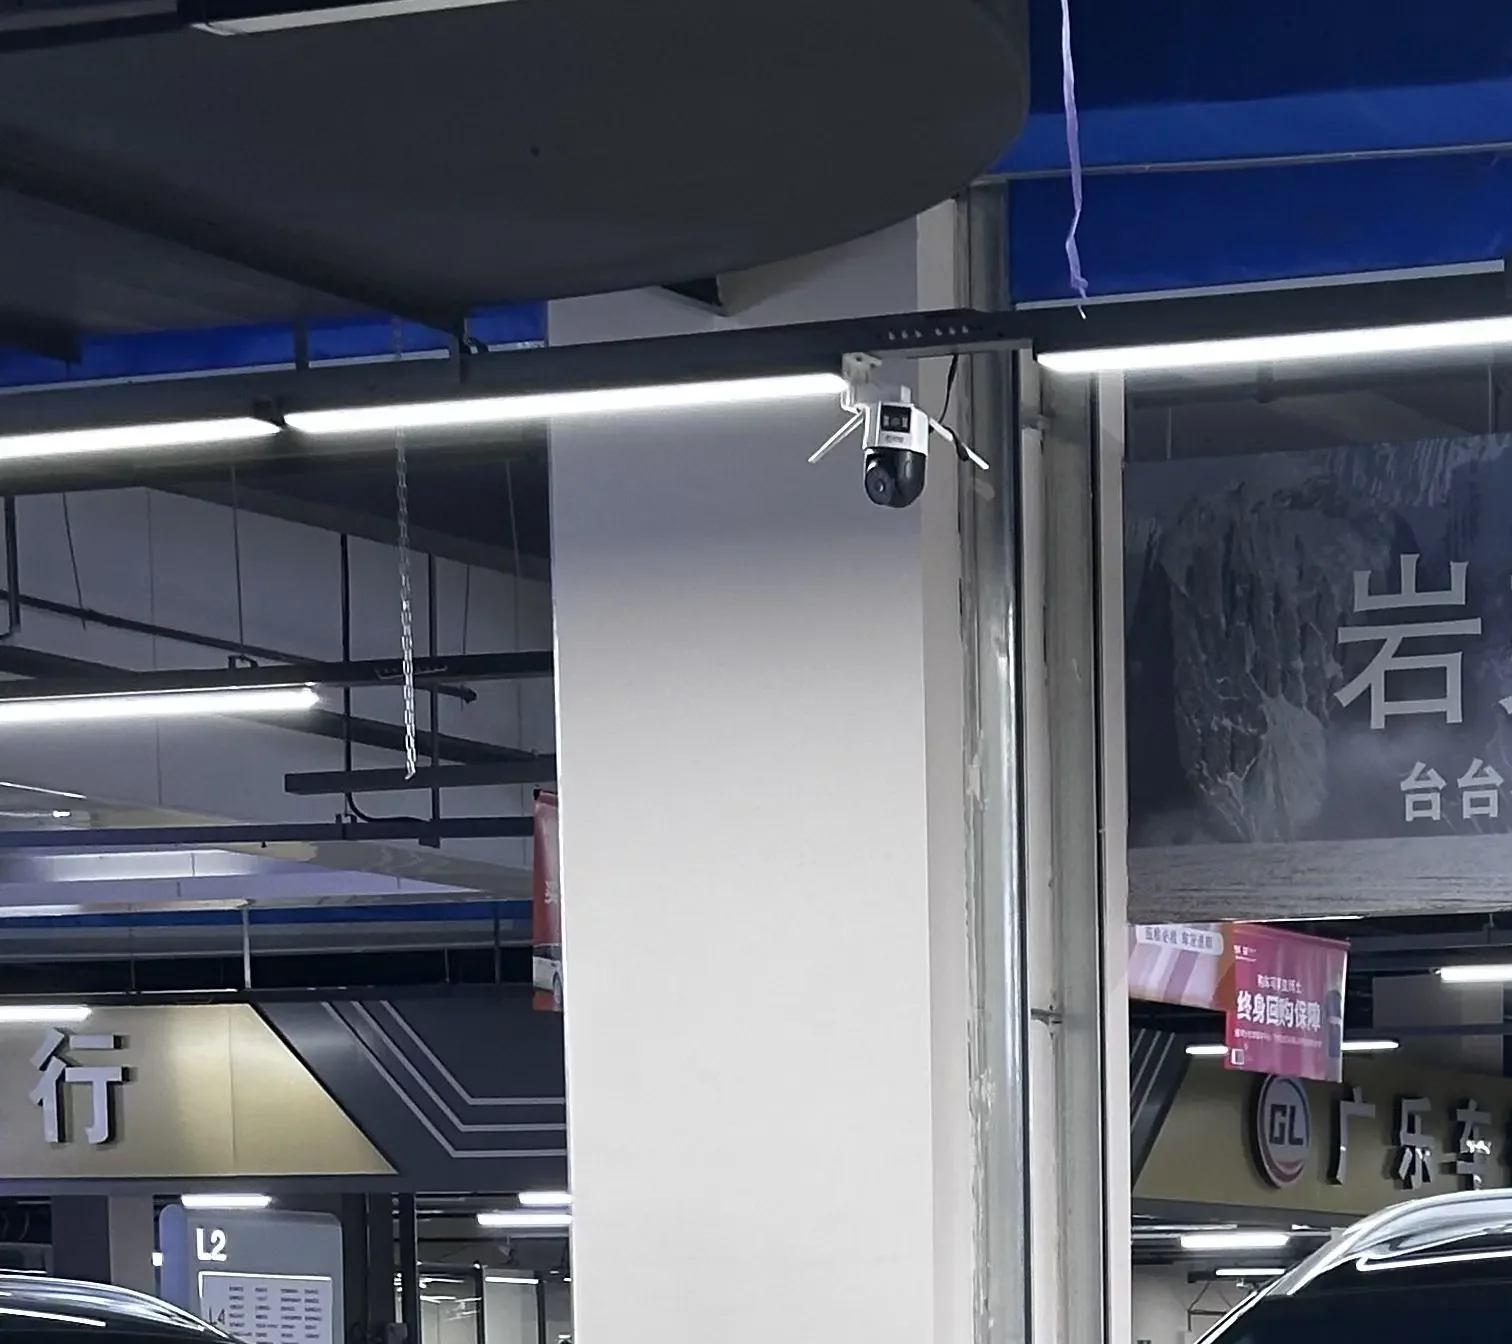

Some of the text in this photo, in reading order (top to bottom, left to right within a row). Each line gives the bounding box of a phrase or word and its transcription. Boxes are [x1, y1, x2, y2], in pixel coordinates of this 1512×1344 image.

[1236, 990, 1322, 1031] 终身回购保障
[29, 1028, 126, 1144] 行
[1269, 1103, 1304, 1146] GL
[195, 1227, 228, 1262] L2
